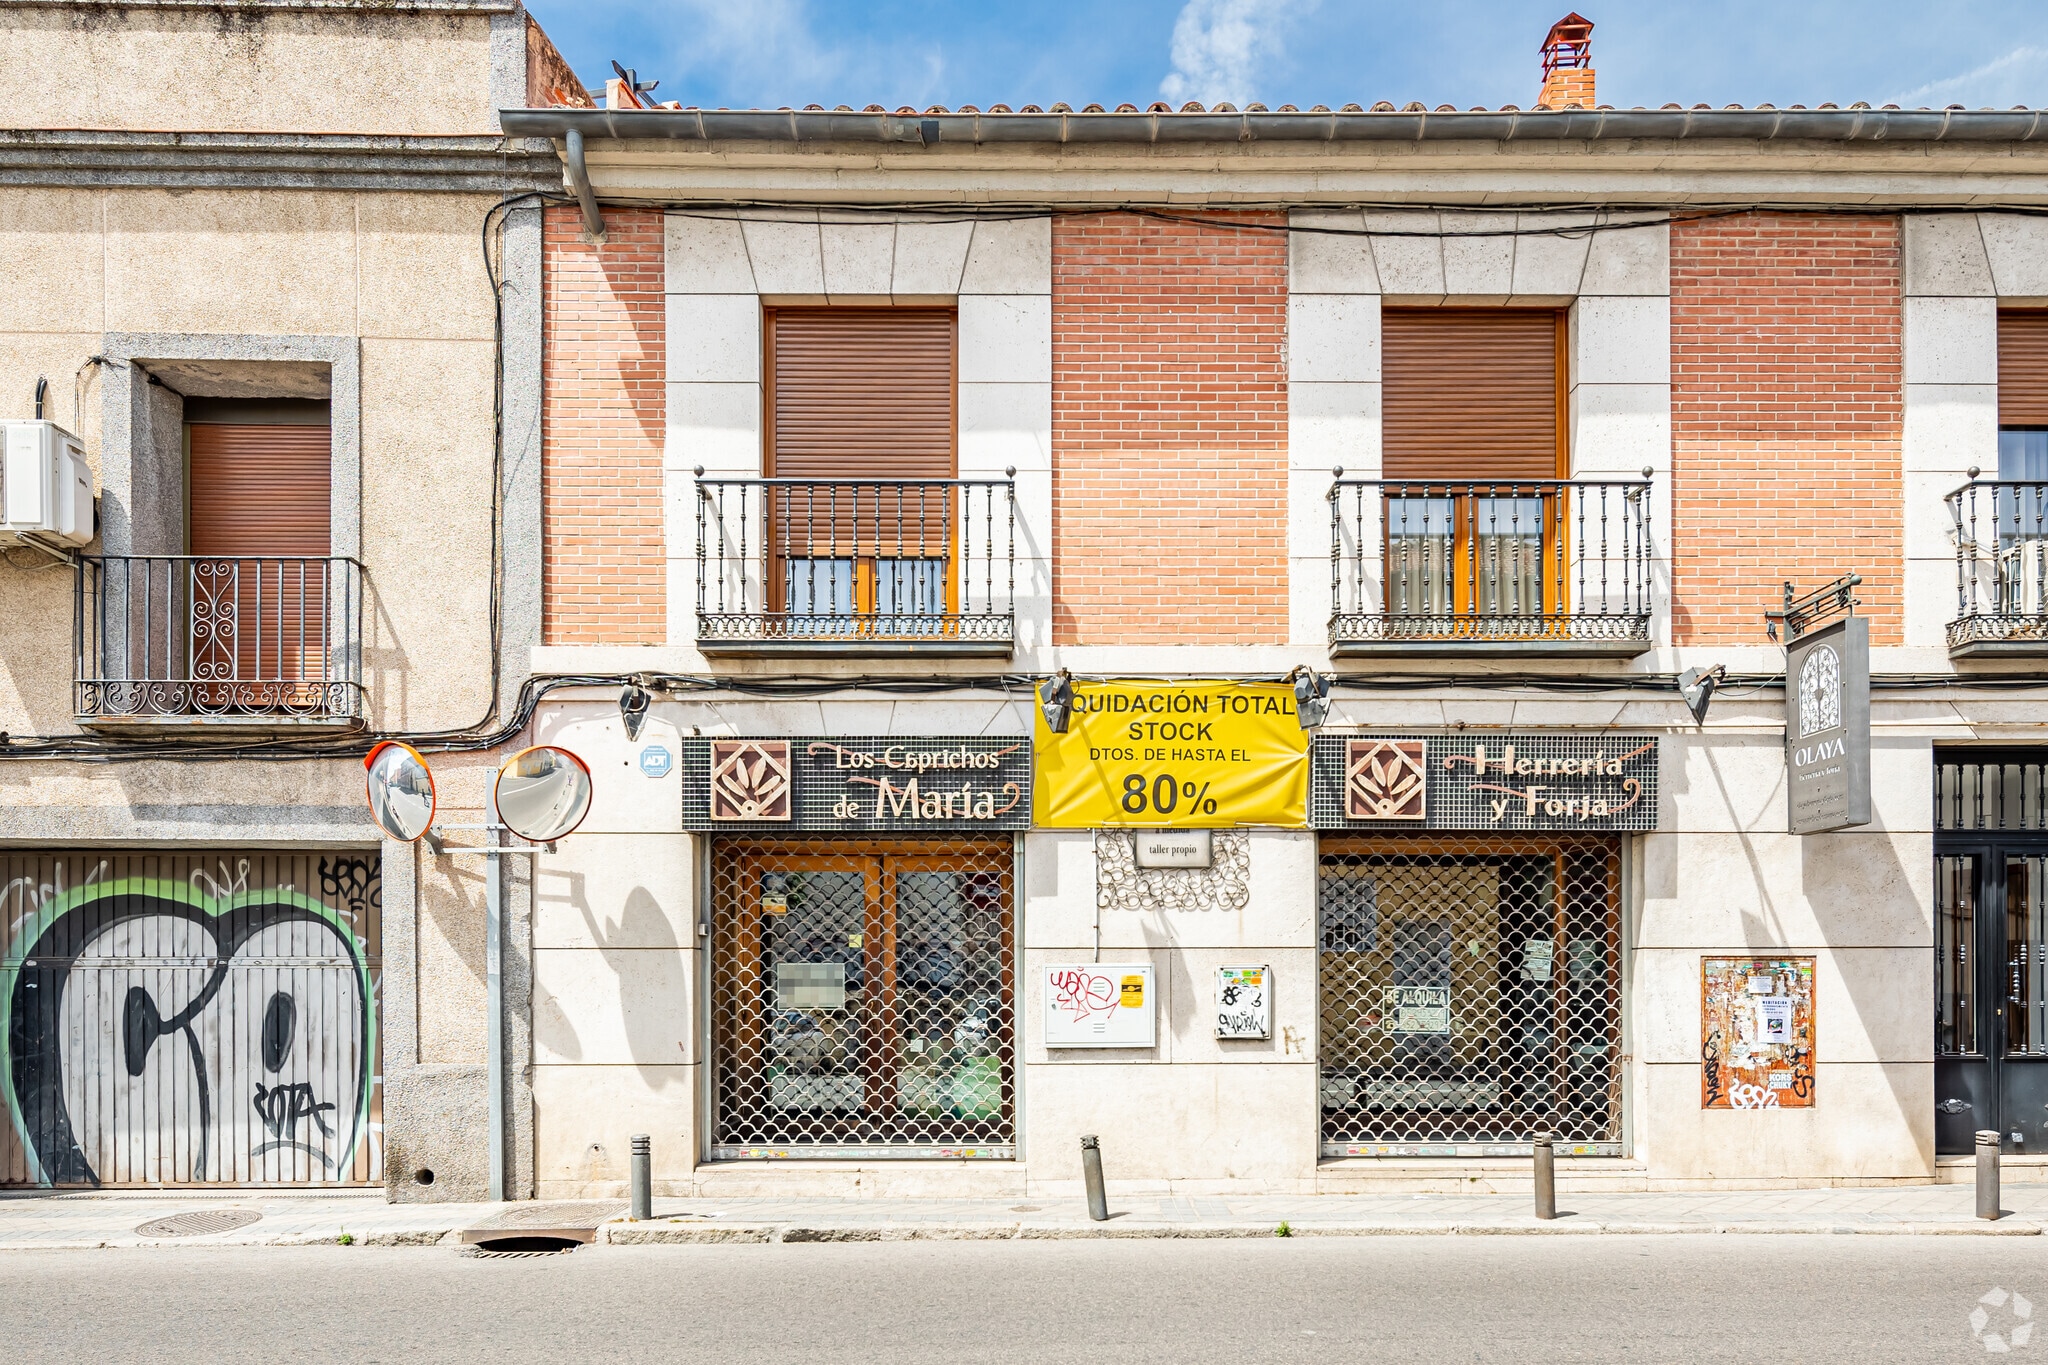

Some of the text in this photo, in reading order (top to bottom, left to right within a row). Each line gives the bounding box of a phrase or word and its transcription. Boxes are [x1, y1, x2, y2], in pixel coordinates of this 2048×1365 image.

[1071, 689, 1296, 715] QUIDACIÓN TOTAL
[1129, 722, 1213, 741] STOCK
[645, 755, 667, 767] ADT
[836, 745, 1000, 773] Los Caprichos
[1090, 748, 1251, 762] DTOS. DE HASTA EL
[1475, 745, 1624, 775] Herrería
[1795, 737, 1845, 766] OLAYA
[833, 777, 997, 820] de María
[1122, 774, 1217, 815] 80%
[1489, 785, 1610, 822] y Forja
[1149, 844, 1197, 856] taller propio
[1402, 990, 1446, 1005] ALQUILA
